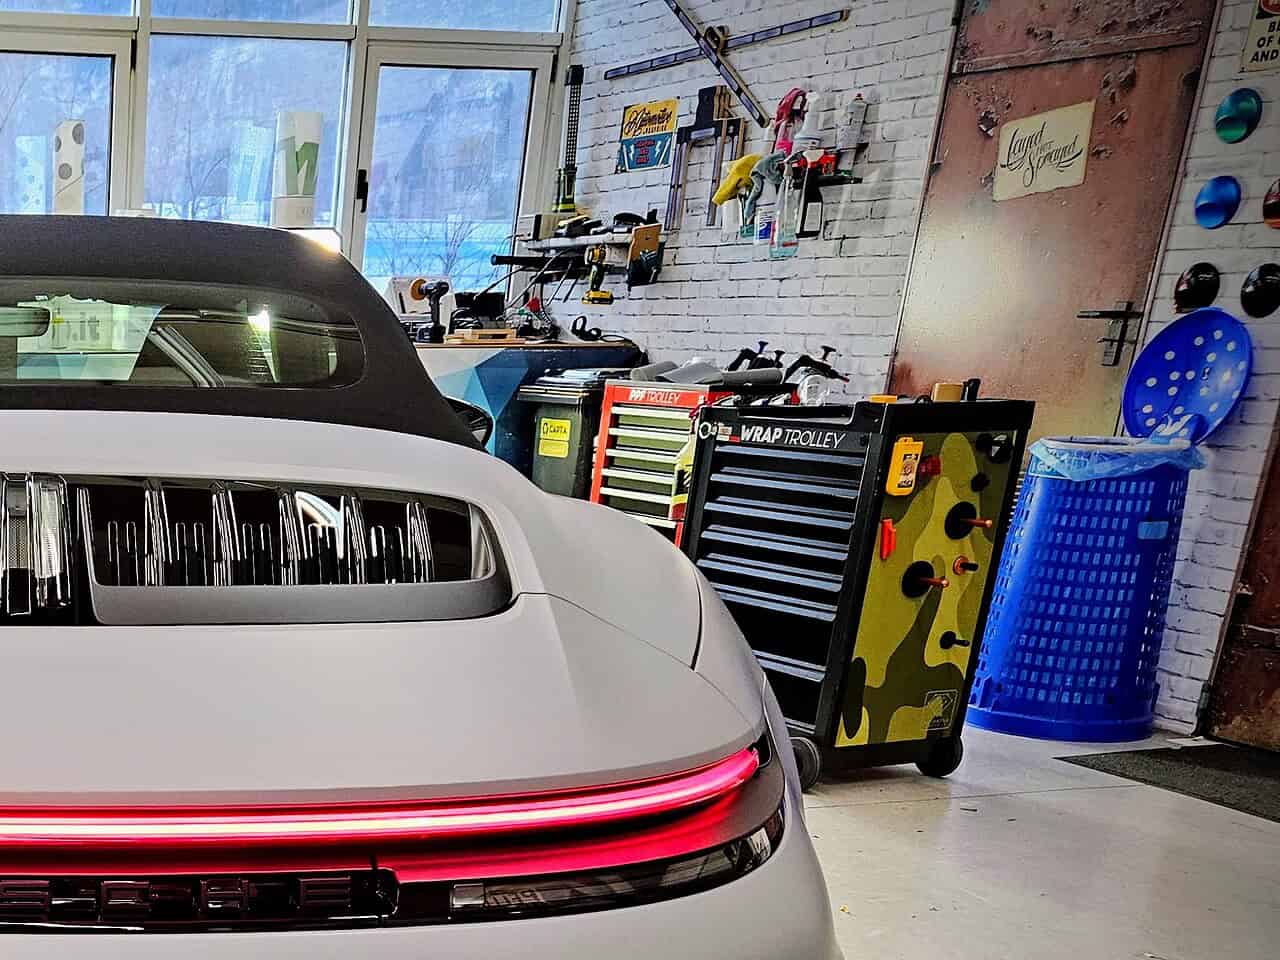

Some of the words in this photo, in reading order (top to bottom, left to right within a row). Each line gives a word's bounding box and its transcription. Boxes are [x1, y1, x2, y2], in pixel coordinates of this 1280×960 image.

[1249, 49, 1279, 63] AND
[644, 390, 681, 404] TROLLEY
[741, 424, 783, 444] WRAP
[783, 428, 847, 449] TROLLEY
